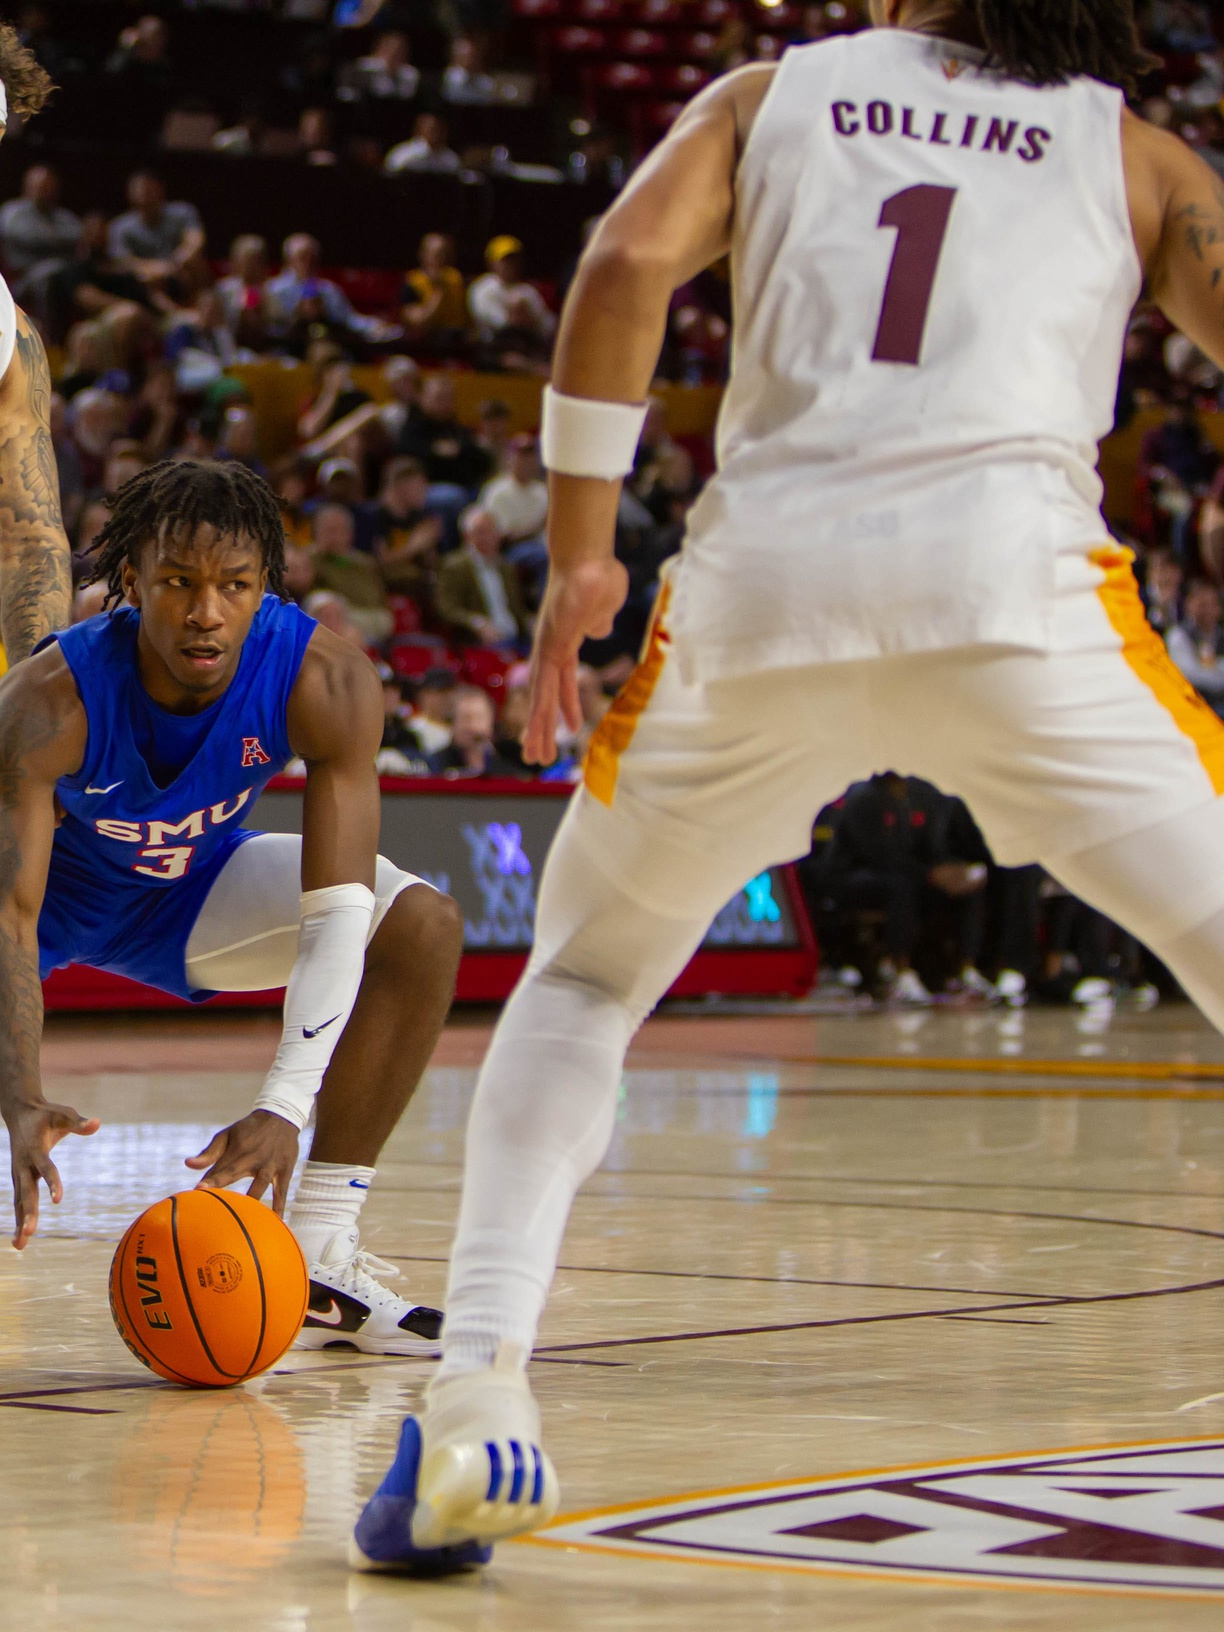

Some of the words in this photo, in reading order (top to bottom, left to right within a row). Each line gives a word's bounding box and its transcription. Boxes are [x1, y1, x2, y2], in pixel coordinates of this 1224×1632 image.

[831, 99, 1052, 162] COLLINS
[871, 183, 958, 366] 1
[95, 786, 254, 846] SMU
[132, 846, 196, 880] 3
[136, 1232, 146, 1254] NXT
[135, 1256, 174, 1331] EVO
